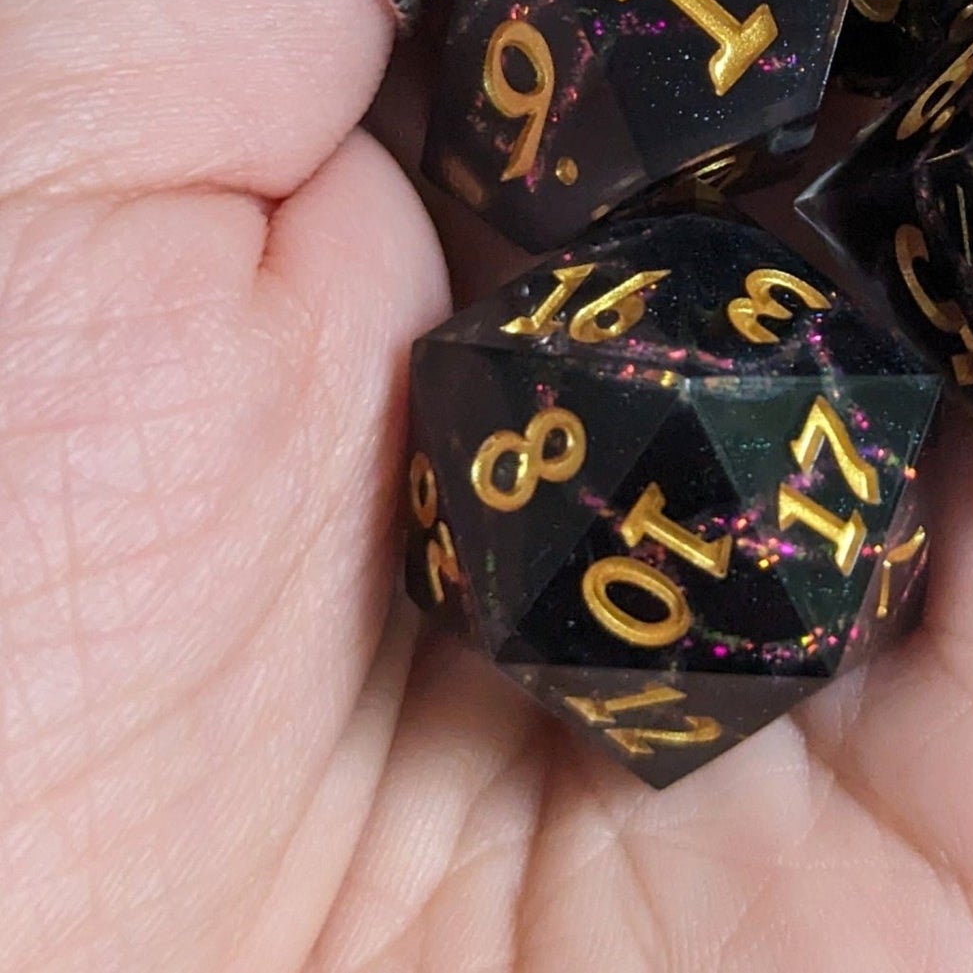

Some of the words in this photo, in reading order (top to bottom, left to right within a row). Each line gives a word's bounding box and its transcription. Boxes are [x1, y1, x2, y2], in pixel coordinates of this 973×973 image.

[499, 262, 672, 344] 16
[727, 268, 833, 345] 3
[471, 406, 587, 513] 8
[778, 394, 881, 578] 17
[581, 481, 733, 648] 10
